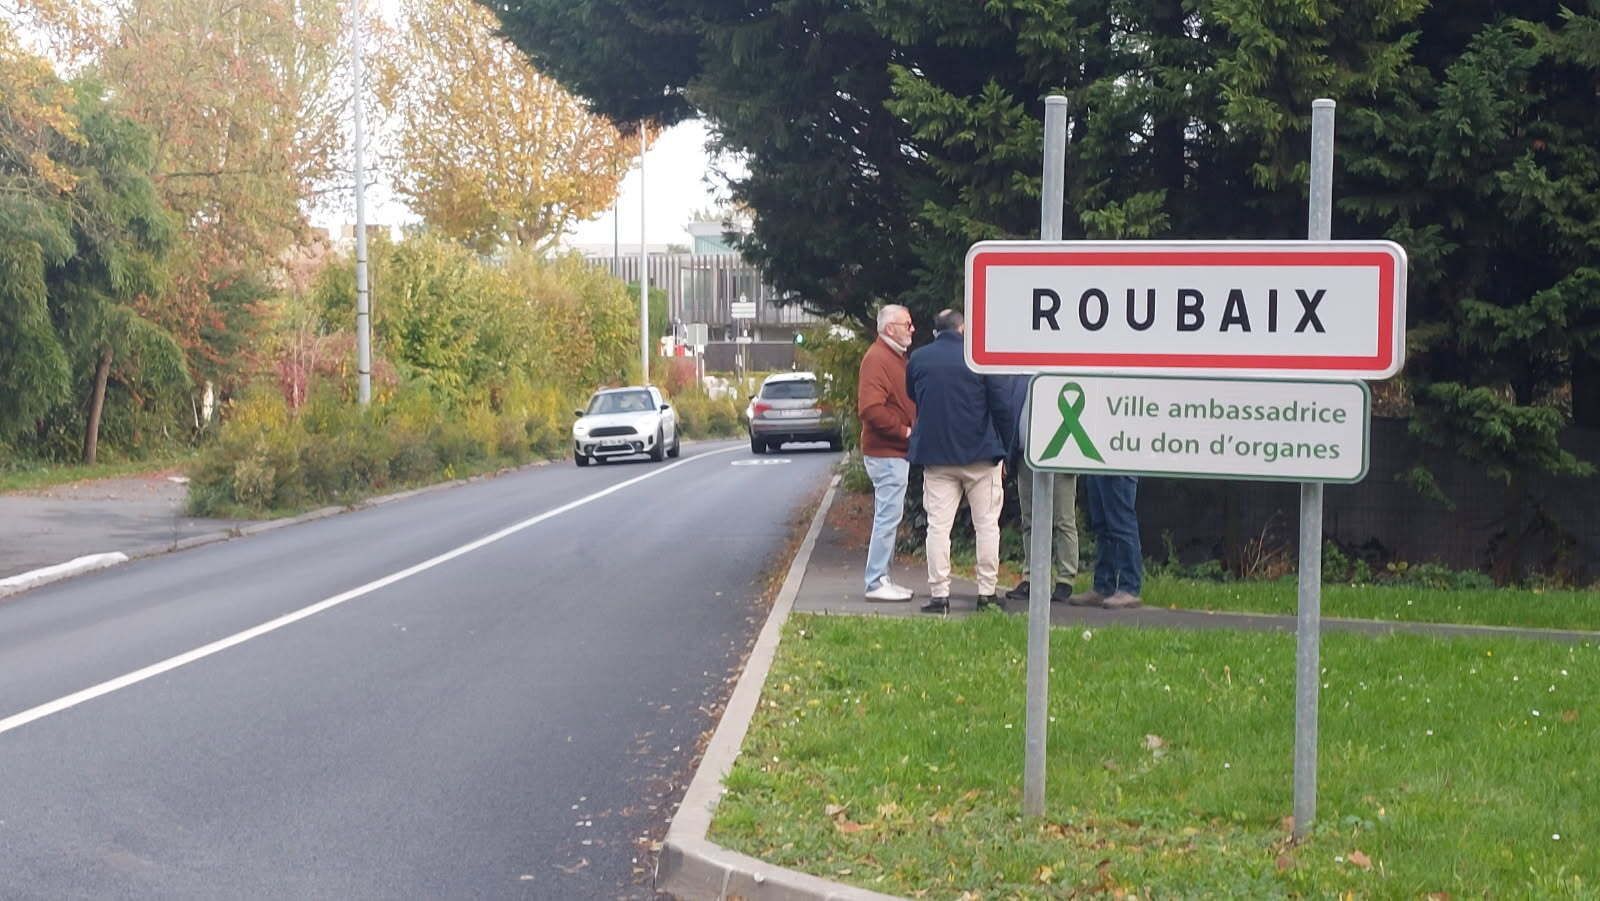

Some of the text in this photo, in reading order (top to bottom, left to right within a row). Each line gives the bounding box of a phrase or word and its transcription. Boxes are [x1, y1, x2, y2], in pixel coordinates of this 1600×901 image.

[1032, 288, 1327, 334] ROUBAIX
[1106, 395, 1347, 424] Ville ambassadrice
[1109, 430, 1340, 463] du don d’organes
